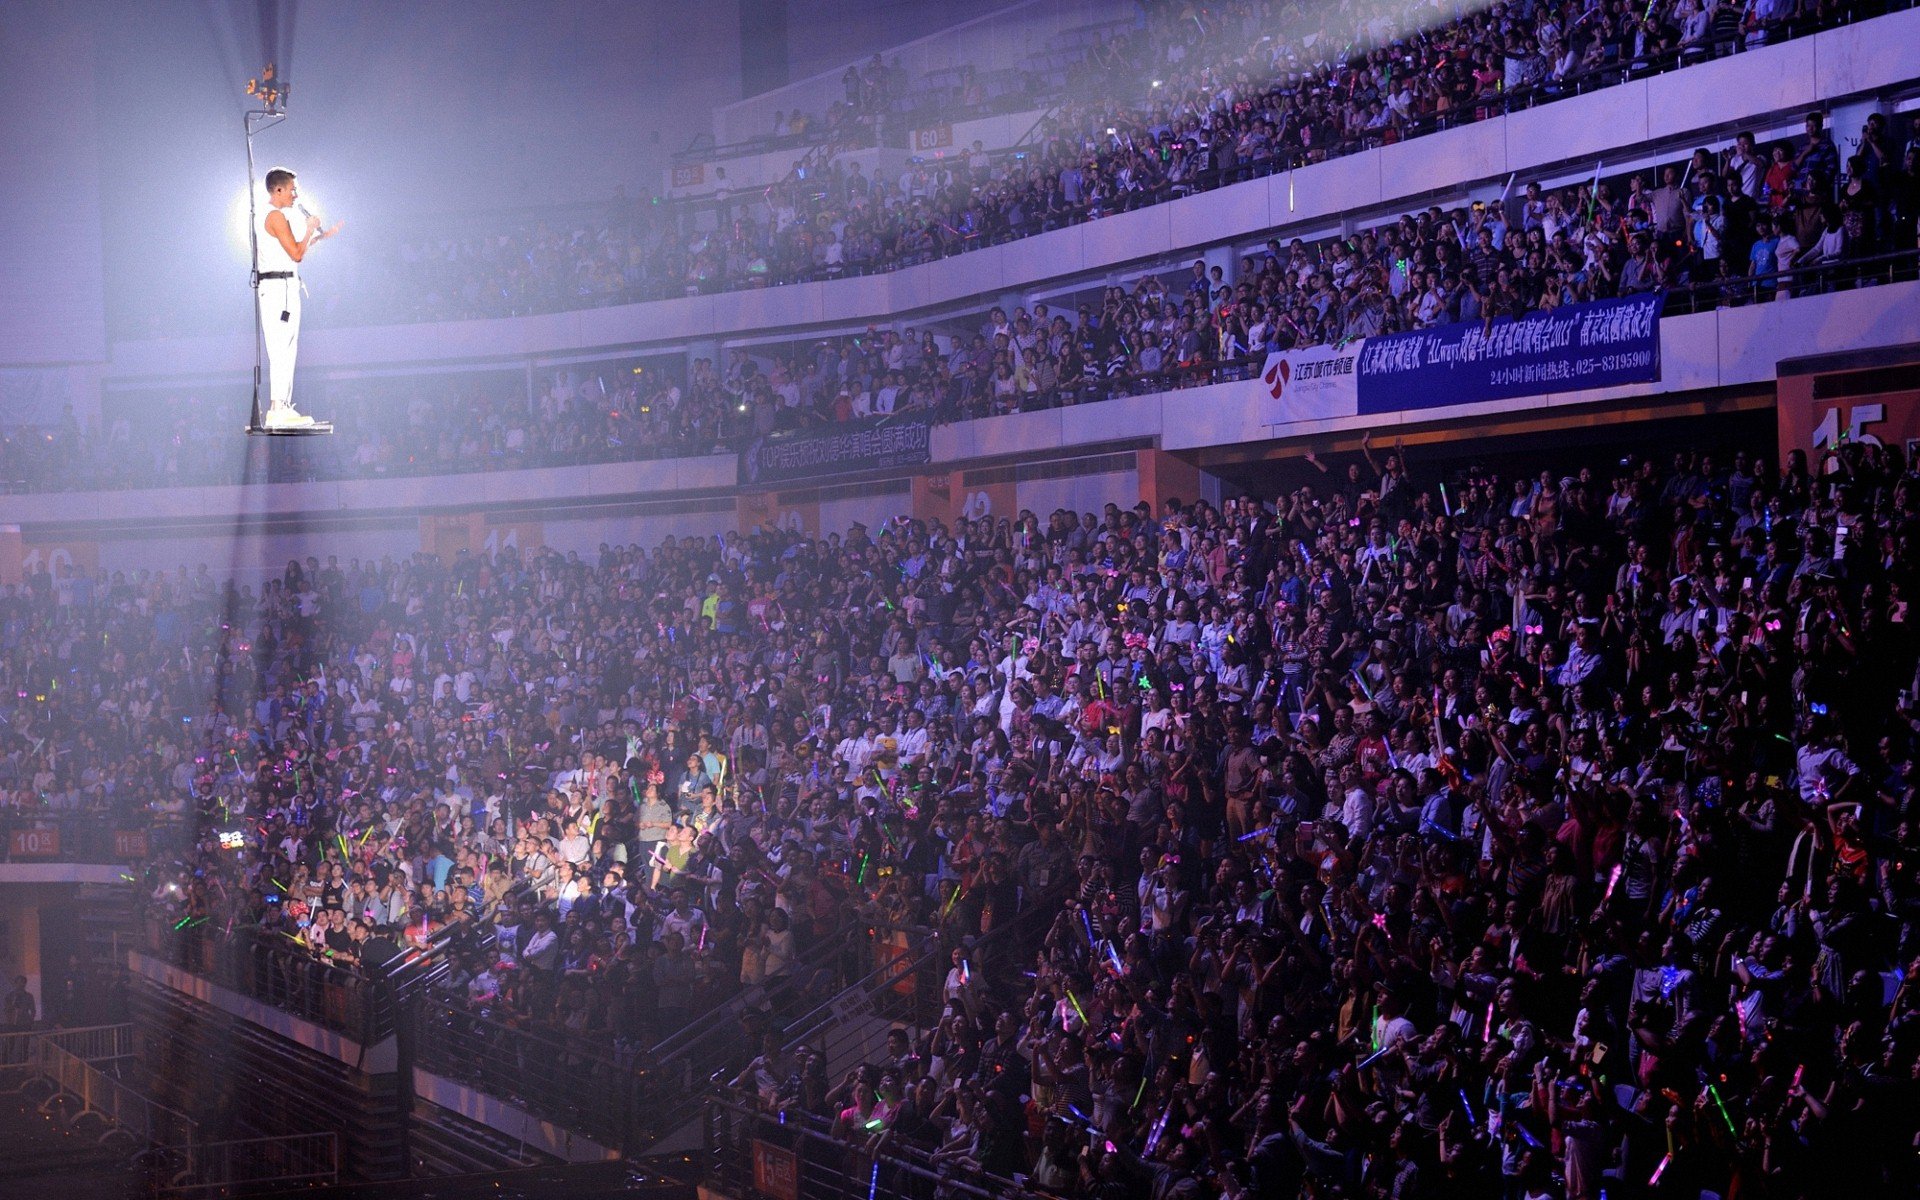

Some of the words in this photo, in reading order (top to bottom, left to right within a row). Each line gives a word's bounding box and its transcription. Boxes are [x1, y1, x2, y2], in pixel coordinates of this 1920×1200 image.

[1294, 356, 1355, 381] 江苏城市频道
